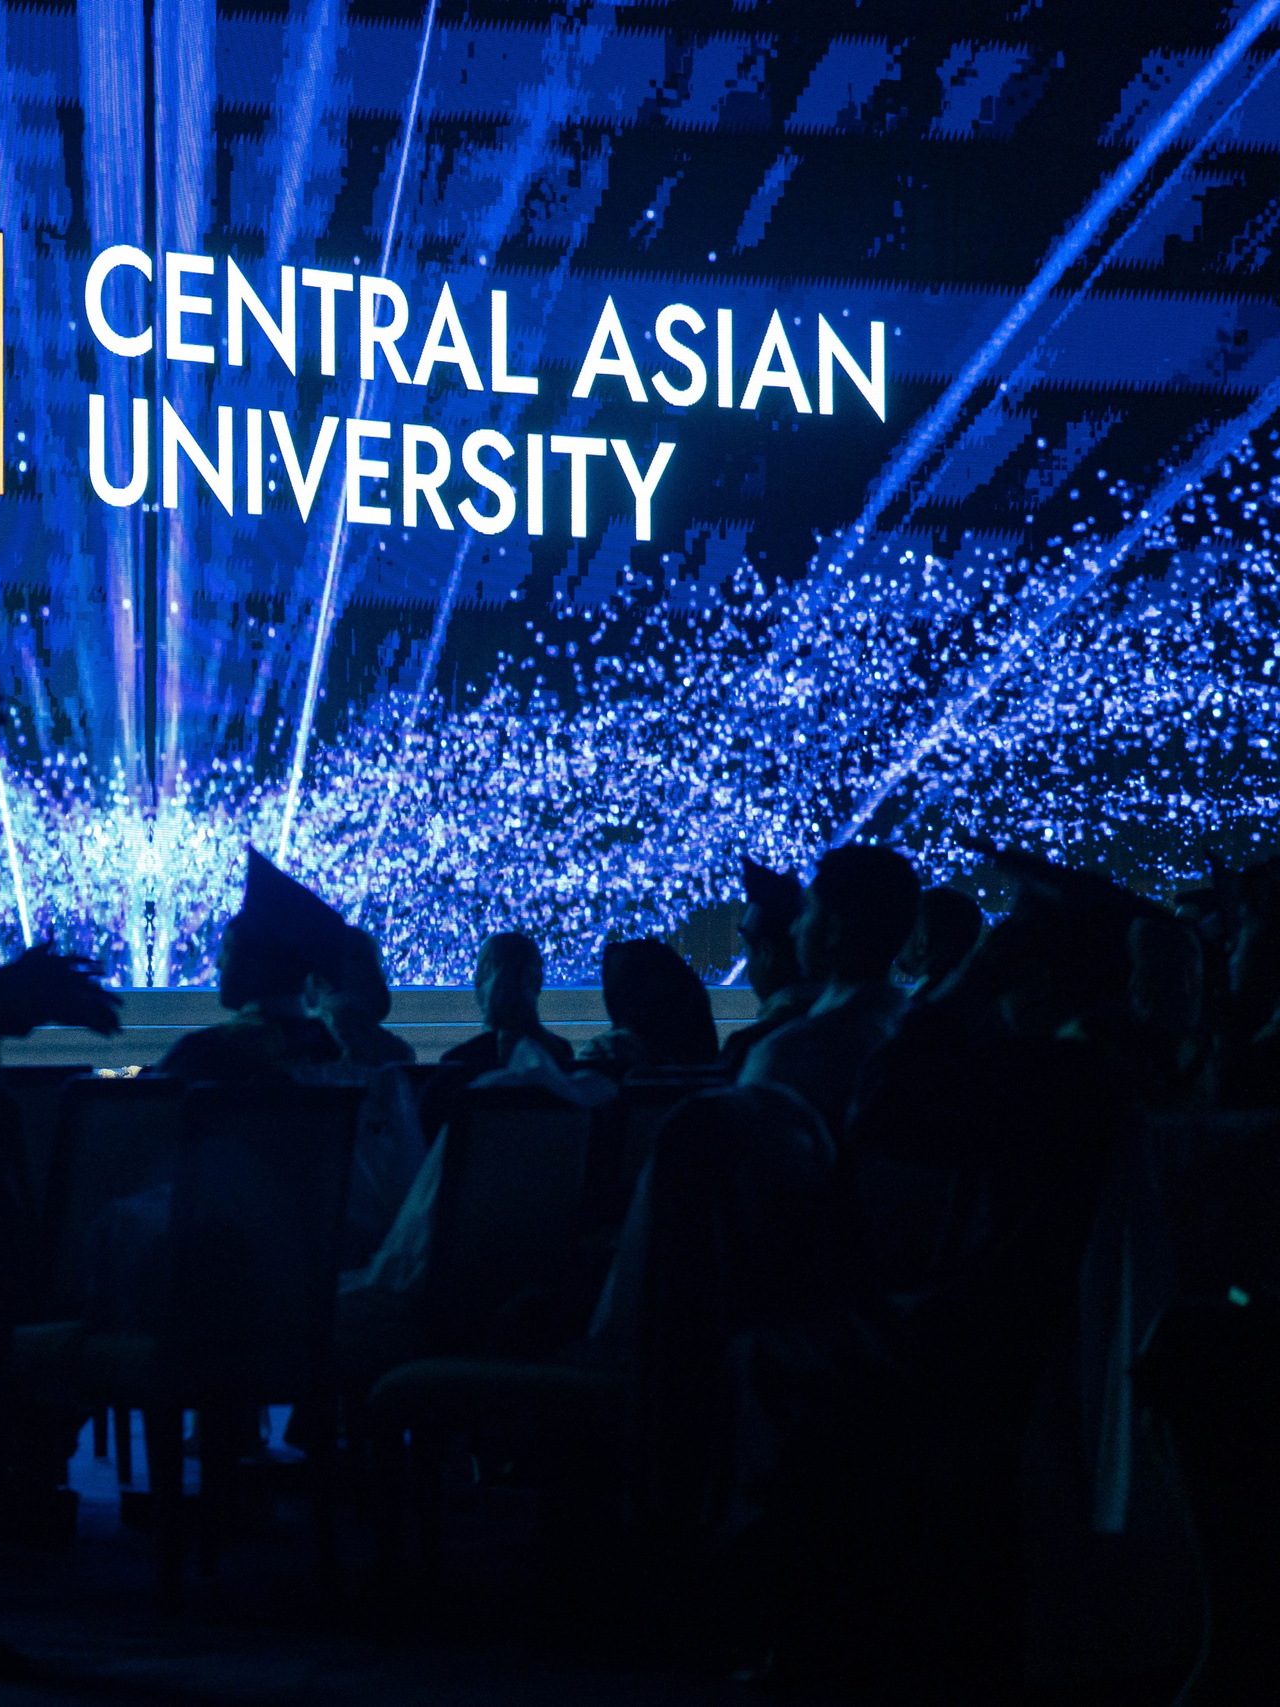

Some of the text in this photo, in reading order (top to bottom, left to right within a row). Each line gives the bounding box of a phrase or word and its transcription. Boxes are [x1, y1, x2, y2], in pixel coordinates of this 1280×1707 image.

[84, 244, 886, 424] CENTRAL ASIAN
[88, 393, 677, 542] UNIVERSITY
